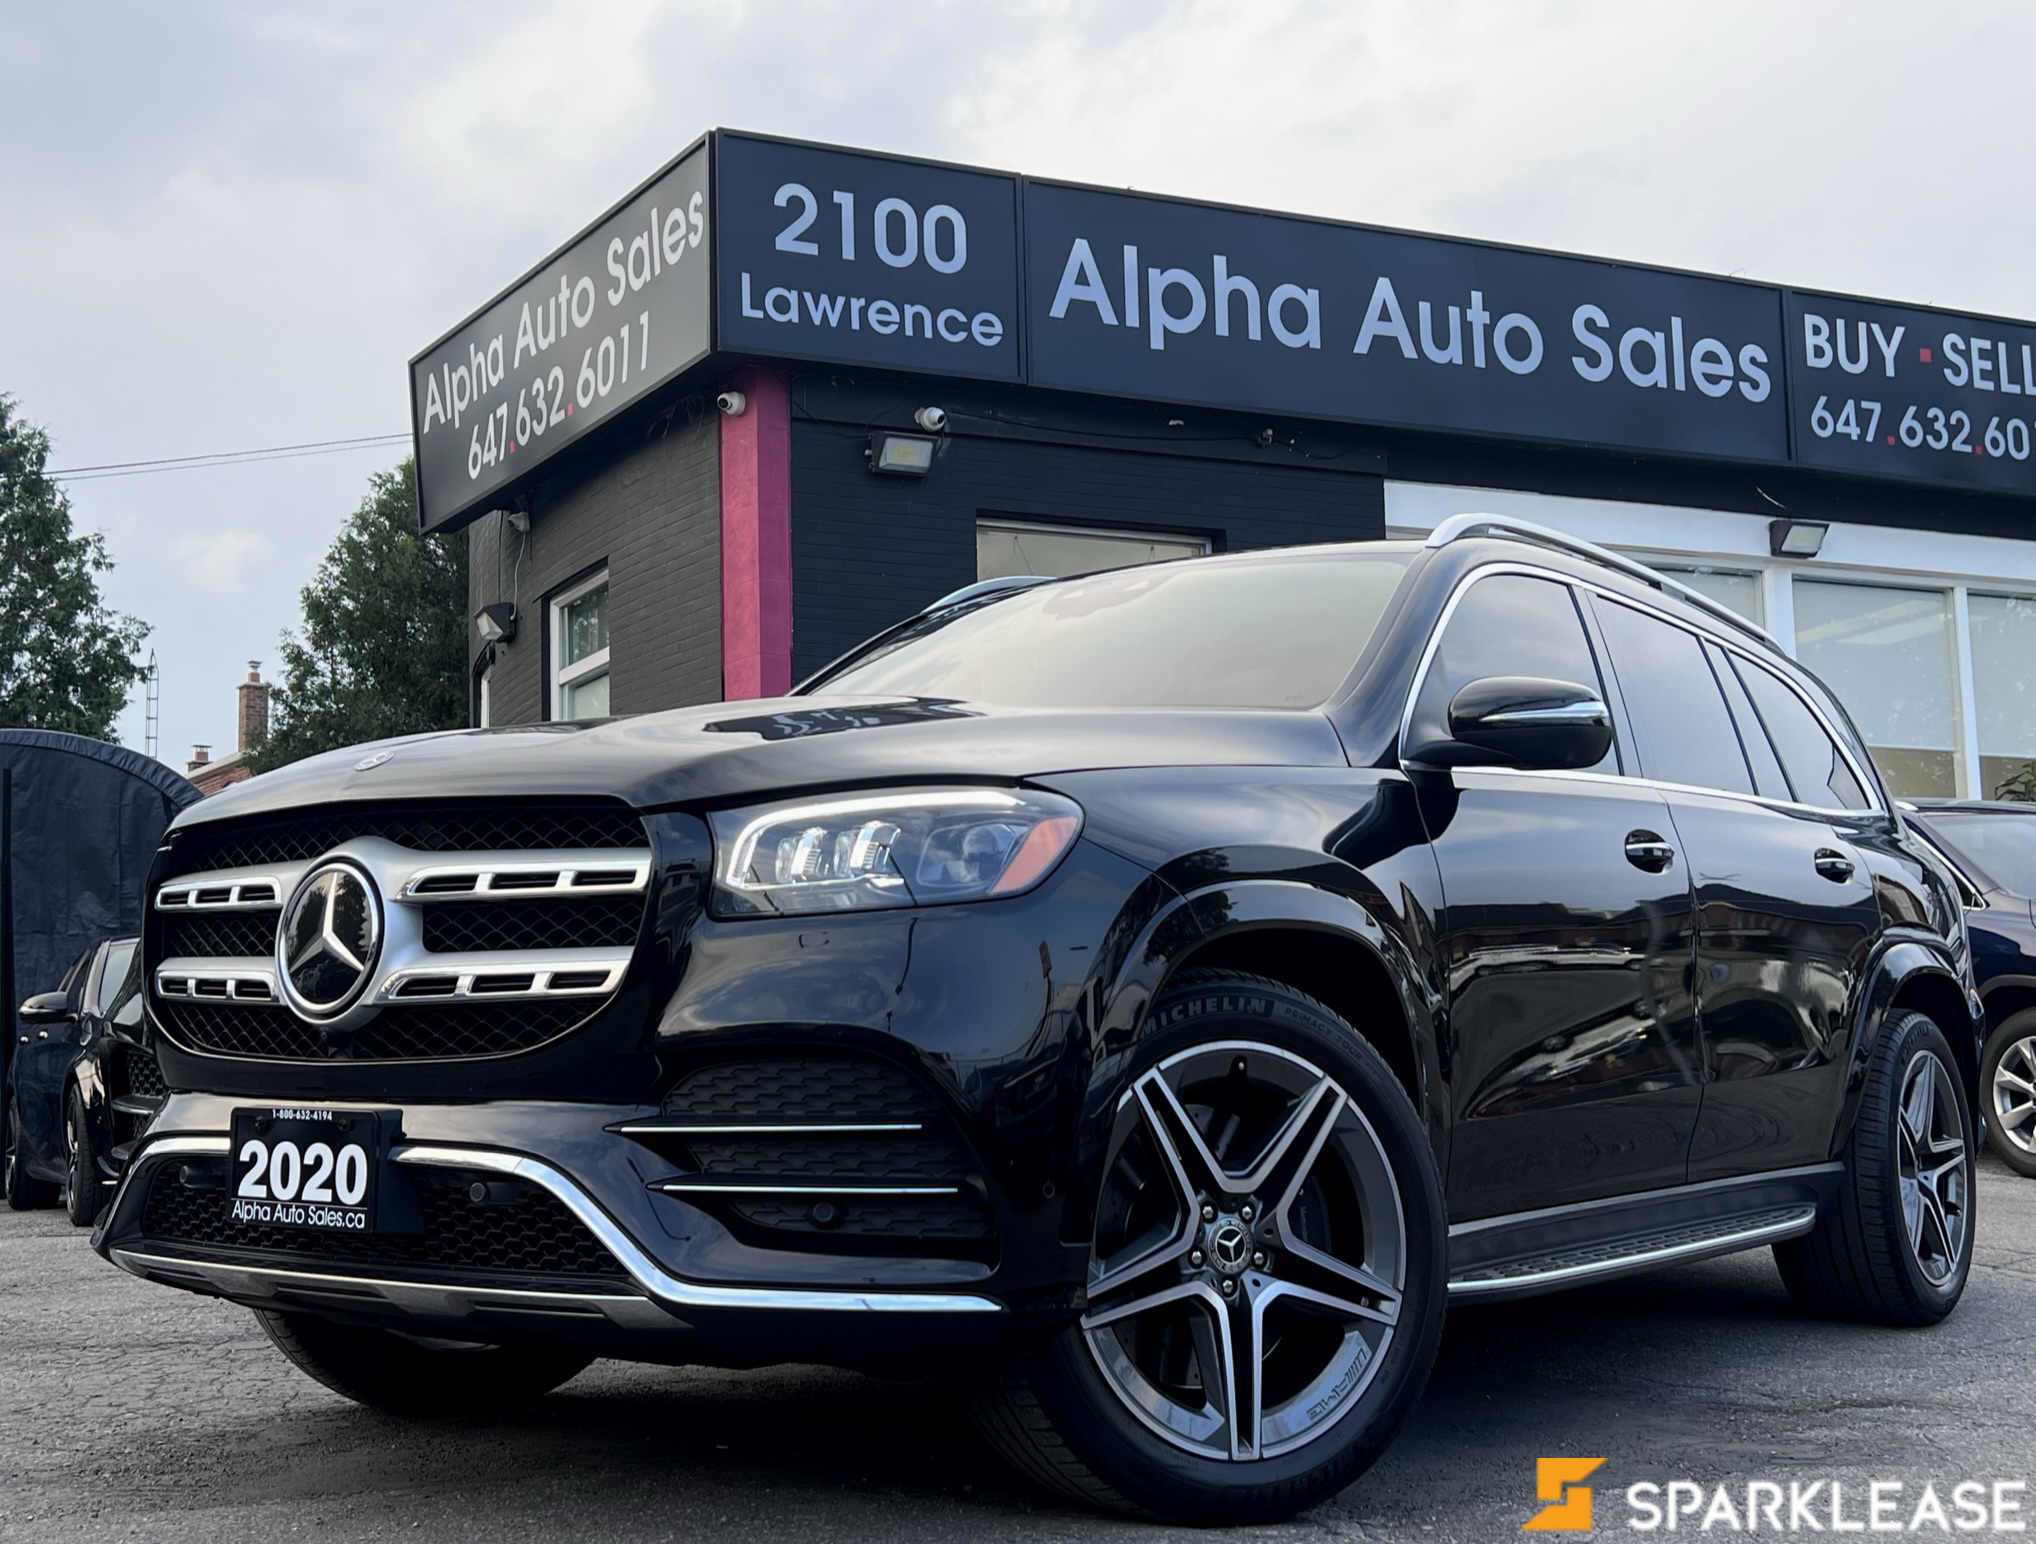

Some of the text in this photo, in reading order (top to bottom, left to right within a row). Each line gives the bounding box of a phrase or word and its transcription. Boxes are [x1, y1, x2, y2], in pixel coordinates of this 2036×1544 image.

[774, 183, 967, 274] 2100
[424, 190, 704, 434] Alpha Auto Sales
[741, 271, 1004, 347] Lawrence
[1049, 238, 1772, 403] Alpha Auto Sales
[467, 310, 649, 480] 647.632.6011
[1803, 313, 2036, 397] BUY SELL
[1810, 395, 2036, 461] 647.632.60
[1141, 996, 1267, 1036] MICHELIN
[237, 1139, 368, 1205] 2020
[232, 1201, 366, 1229] Alpha Auto Sales.ca
